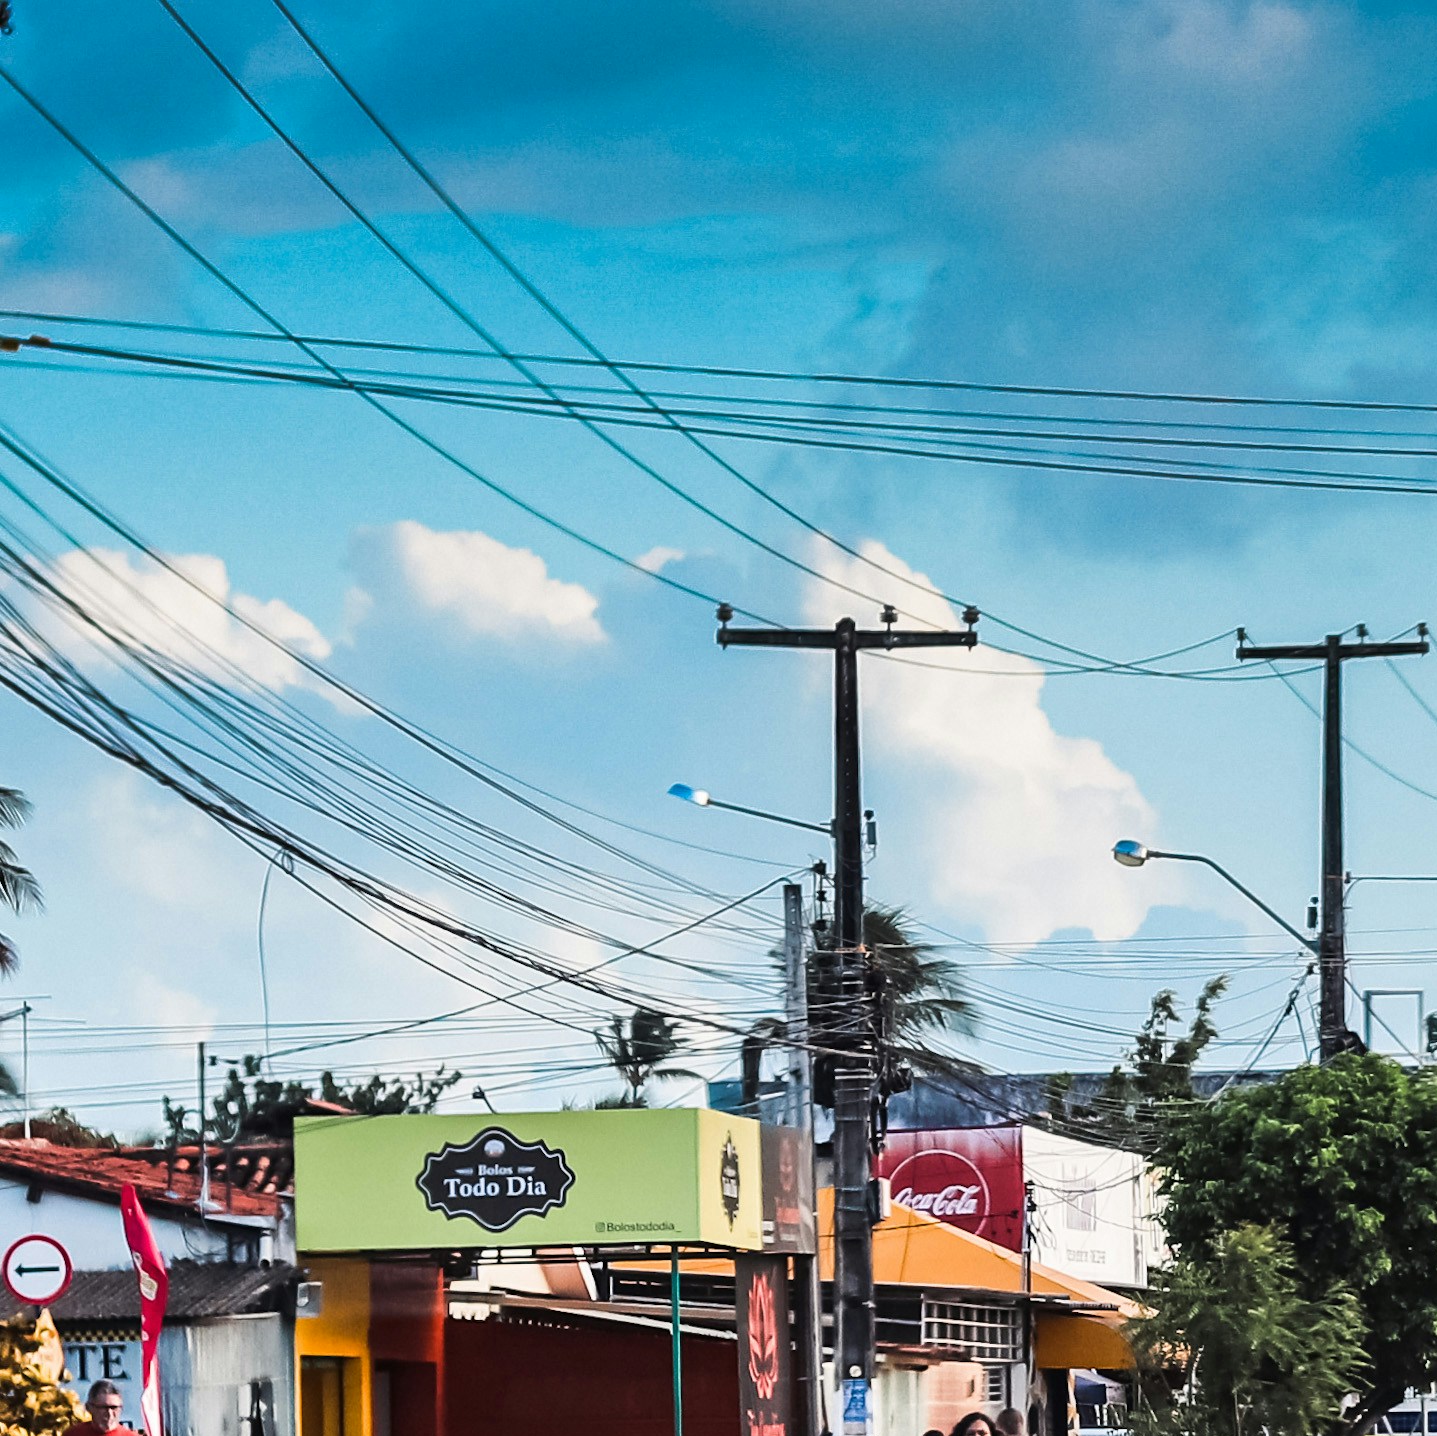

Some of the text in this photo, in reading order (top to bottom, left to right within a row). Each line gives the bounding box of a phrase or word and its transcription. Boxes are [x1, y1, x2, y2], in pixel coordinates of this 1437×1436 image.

[478, 1164, 513, 1176] Bolos
[443, 1176, 547, 1198] Todo Dia
[893, 1185, 981, 1217] Coca-Cola
[66, 1343, 132, 1382] TE
